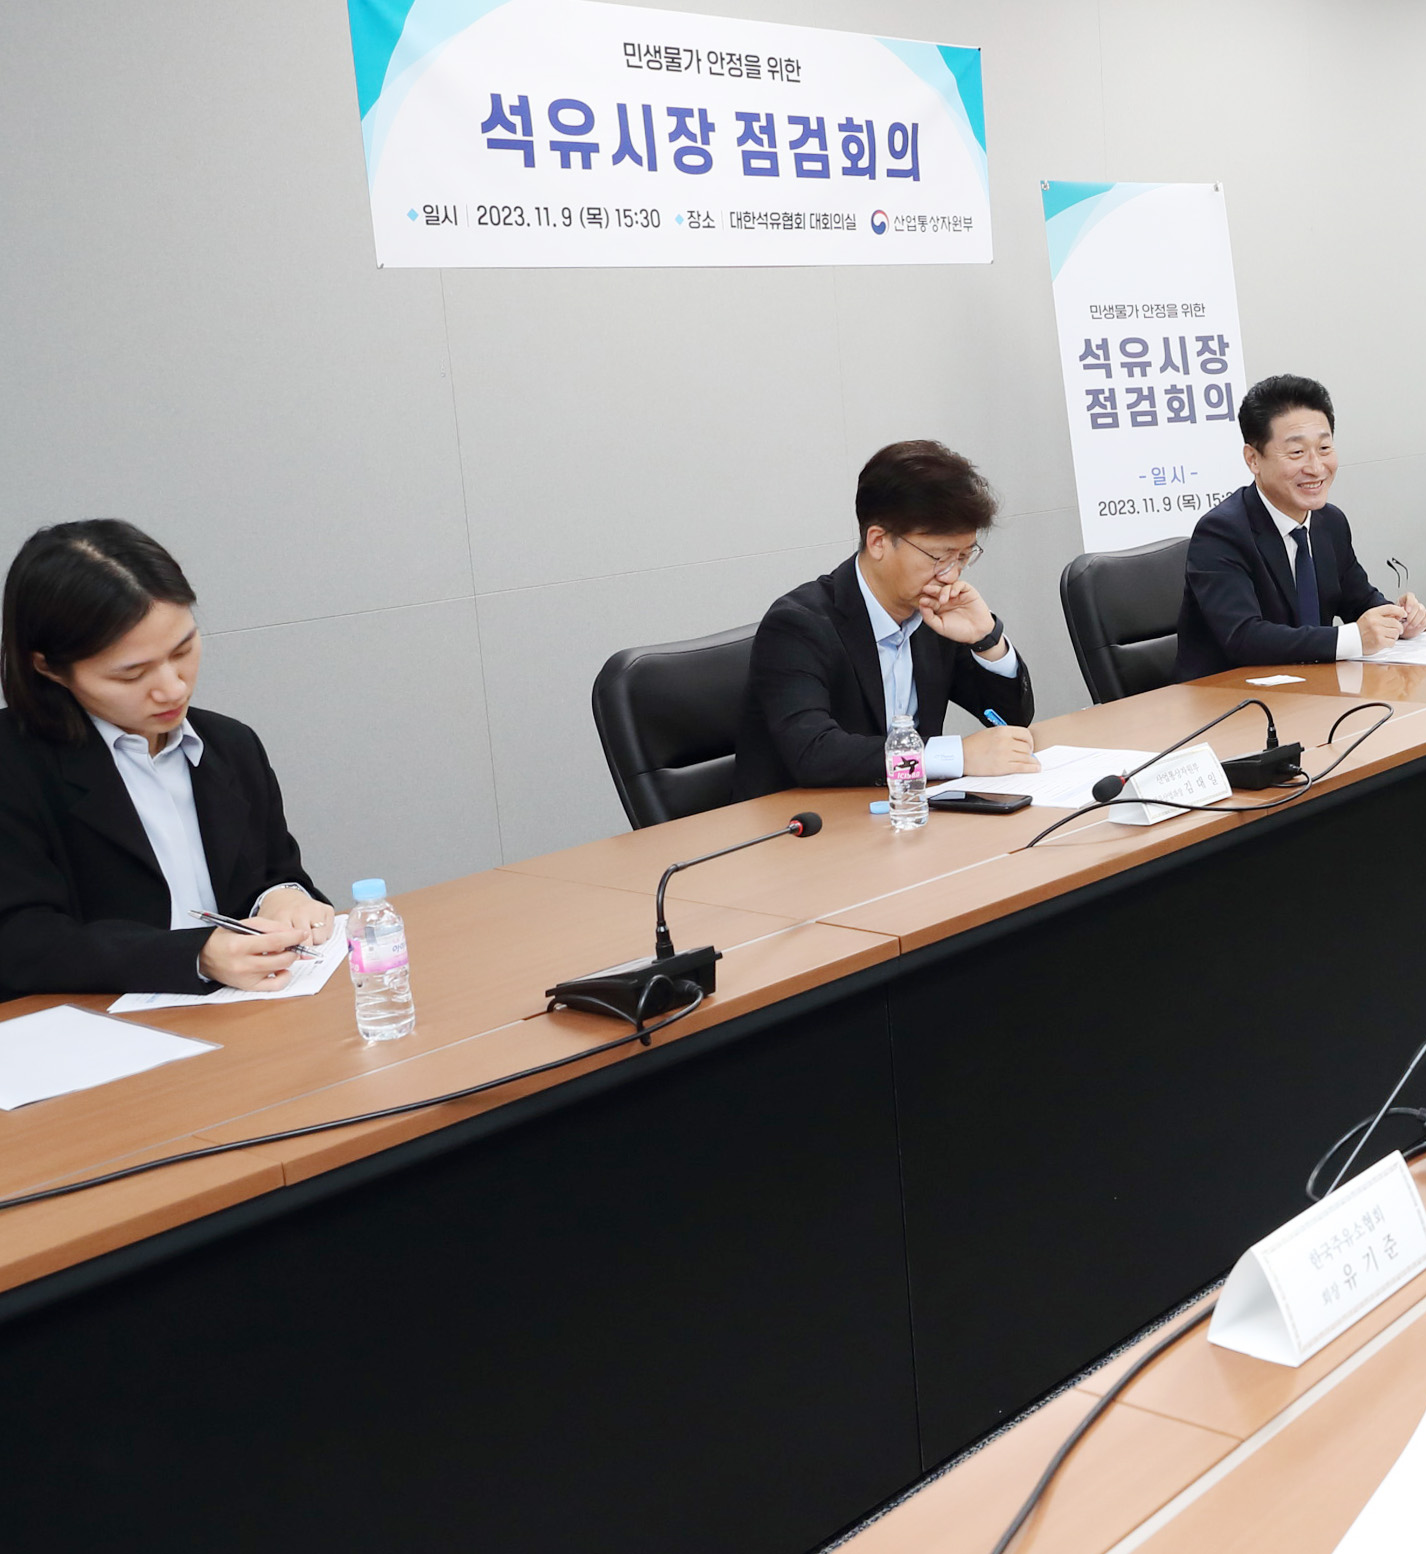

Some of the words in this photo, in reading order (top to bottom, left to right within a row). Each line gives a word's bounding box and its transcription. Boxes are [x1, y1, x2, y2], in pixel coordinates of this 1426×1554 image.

[622, 41, 703, 75] 민생물가
[706, 50, 762, 80] 안정을
[766, 56, 802, 84] 위한
[480, 92, 716, 176] 석유시장
[734, 111, 921, 183] 점검회의
[422, 204, 459, 227] 일시
[579, 206, 610, 230] (목)
[614, 208, 661, 229] 15:30
[686, 210, 716, 230] 장소
[729, 210, 806, 231] 대한석유협회
[809, 212, 857, 231] 대회의실
[893, 214, 974, 233] 산업통상자원부
[1089, 304, 1140, 320] 민생물가
[1141, 303, 1179, 319] 안정을
[1180, 302, 1206, 318] 위한
[1078, 334, 1230, 380] 석유시장
[1085, 381, 1236, 430] 점검회의
[1176, 493, 1202, 512] (목)
[1309, 1204, 1386, 1270] 한국주유소협회
[1343, 1233, 1399, 1290] 유기준
